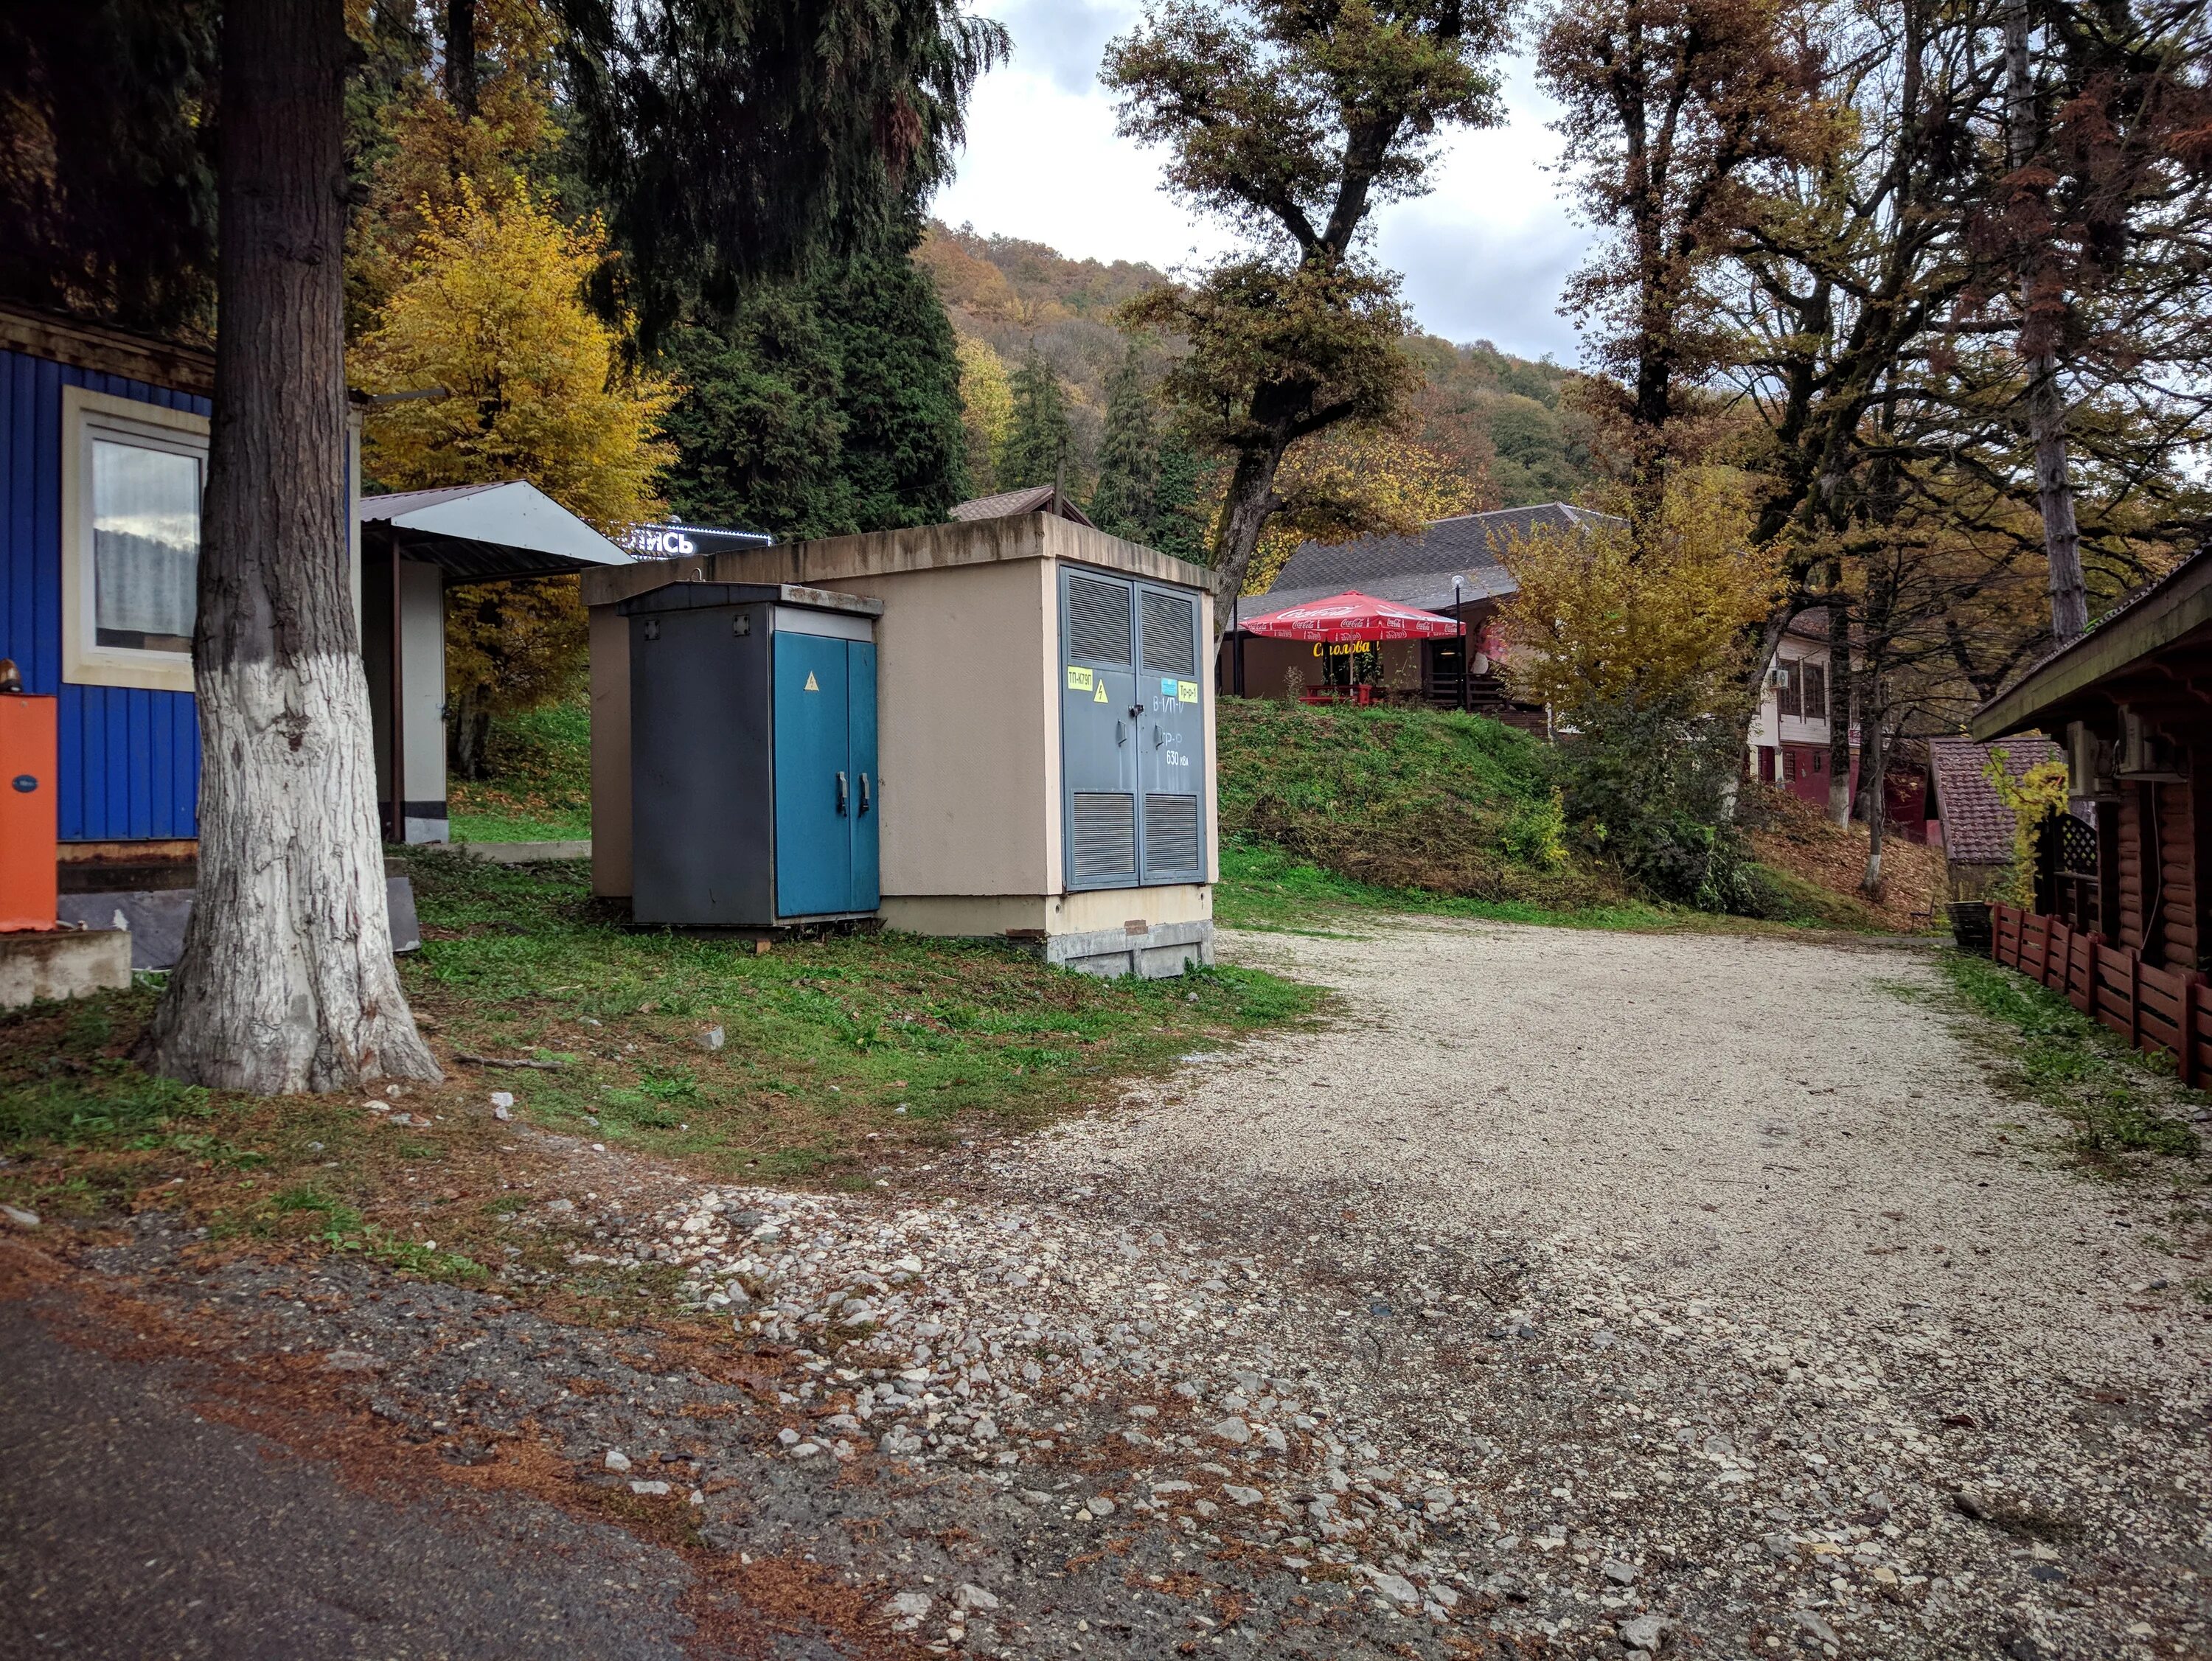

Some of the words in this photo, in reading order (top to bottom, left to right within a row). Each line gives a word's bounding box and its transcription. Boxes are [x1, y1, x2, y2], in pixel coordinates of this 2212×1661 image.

[1068, 672, 1092, 686] ТП-К79П
[1180, 685, 1196, 699] Тр-р-1
[1166, 750, 1178, 765] 630
